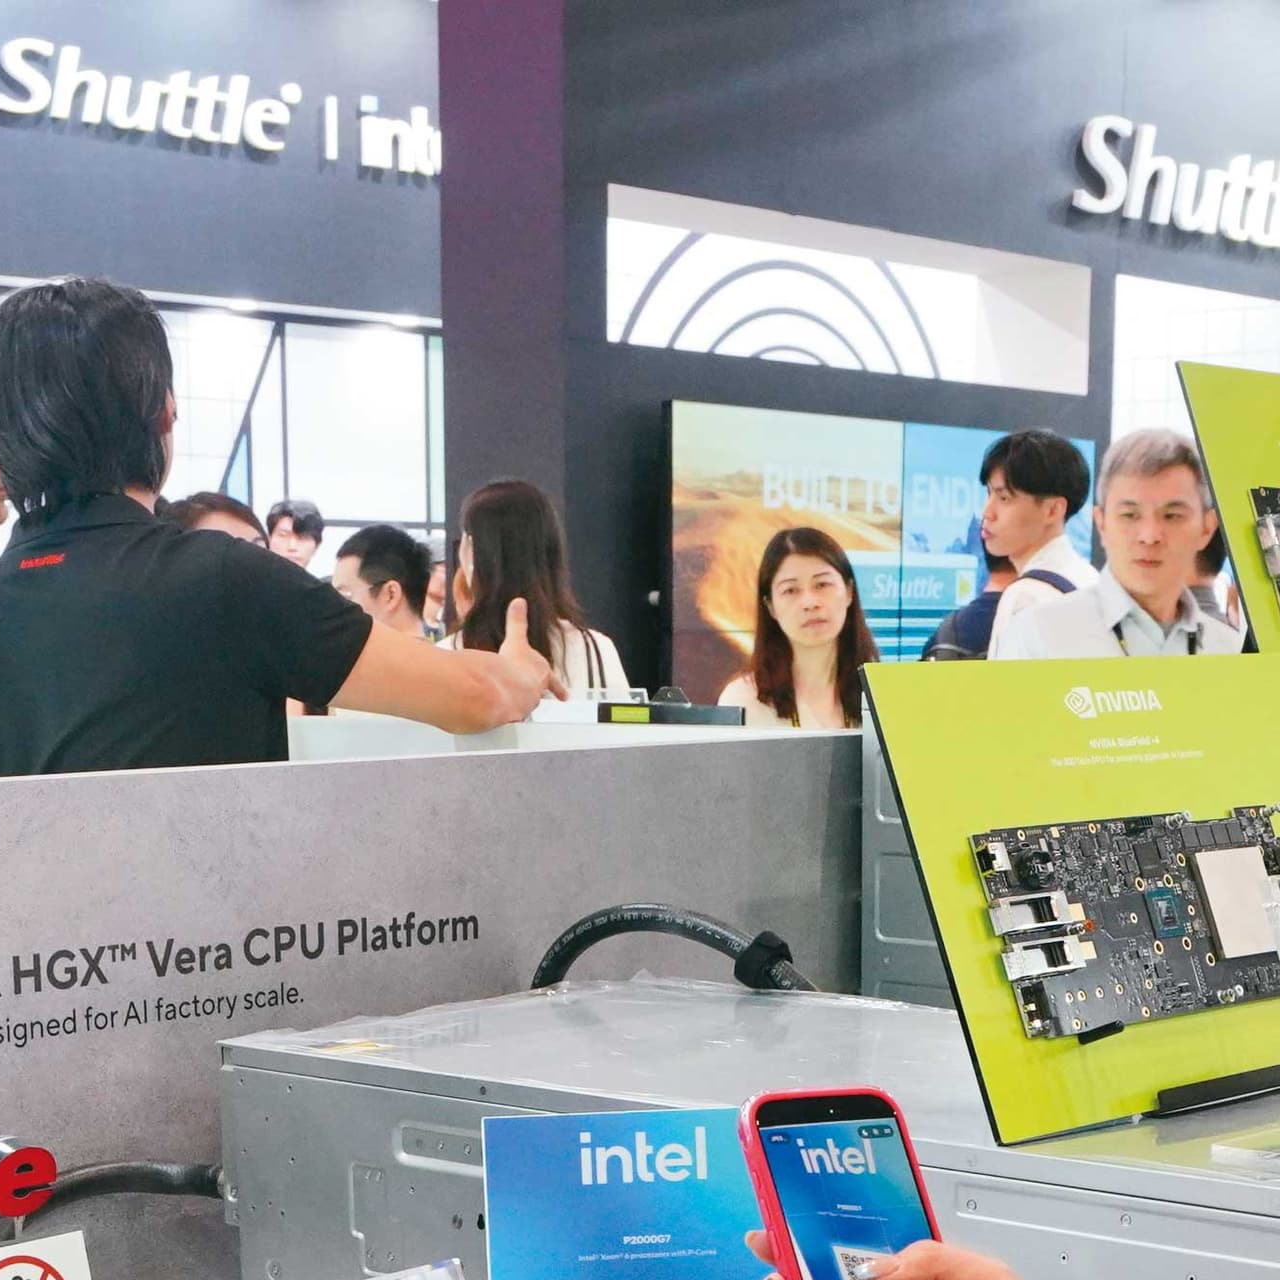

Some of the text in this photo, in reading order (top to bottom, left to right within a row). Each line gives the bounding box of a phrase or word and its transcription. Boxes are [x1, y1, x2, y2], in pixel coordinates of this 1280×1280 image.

[358, 96, 442, 177] int
[871, 573, 944, 602] Shuttle
[1095, 689, 1162, 713] NVIDIA
[146, 938, 232, 977] Vera
[243, 924, 325, 967] CPU
[337, 910, 480, 956] Platform
[84, 1005, 119, 1032] for
[123, 1001, 150, 1027] AI
[155, 990, 237, 1023] factory
[243, 982, 304, 1011] scale.
[579, 1126, 708, 1185] intel
[796, 1138, 876, 1175] intel
[623, 1233, 672, 1246] P2000G7
